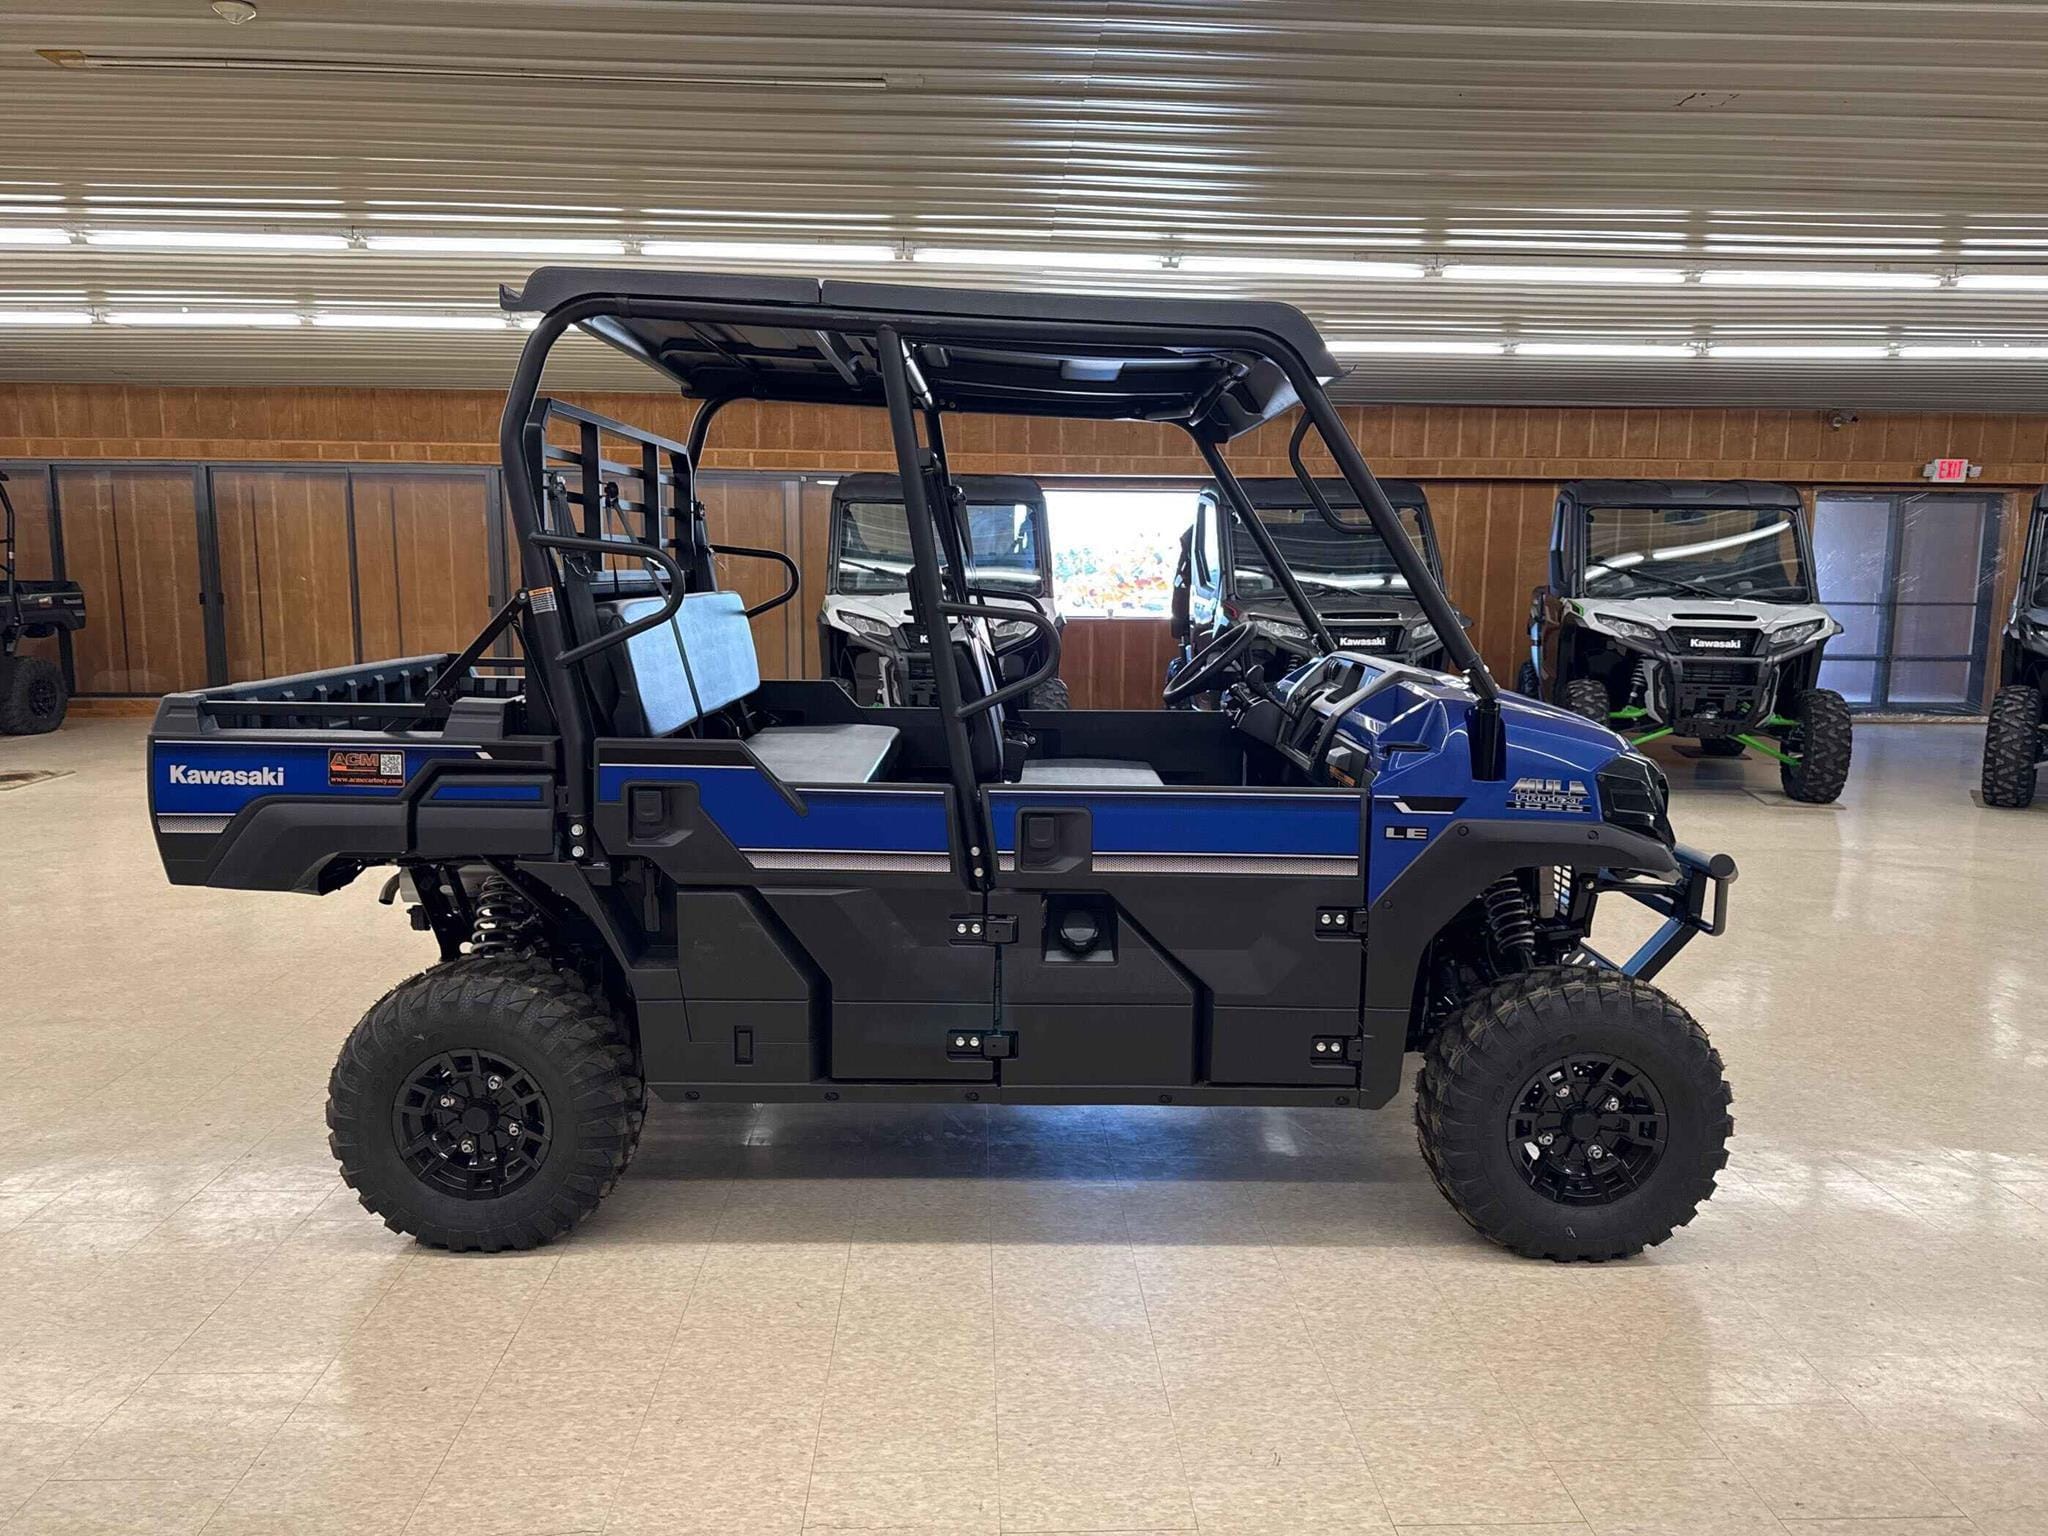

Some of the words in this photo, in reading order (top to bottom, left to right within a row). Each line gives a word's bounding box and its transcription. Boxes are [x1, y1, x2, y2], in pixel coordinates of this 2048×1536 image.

[1936, 460, 1965, 478] EXIT
[1339, 637, 1386, 646] Kawasaki
[1689, 638, 1741, 649] Kawasaki
[169, 764, 284, 786] Kawasaki
[1386, 827, 1428, 840] LE
